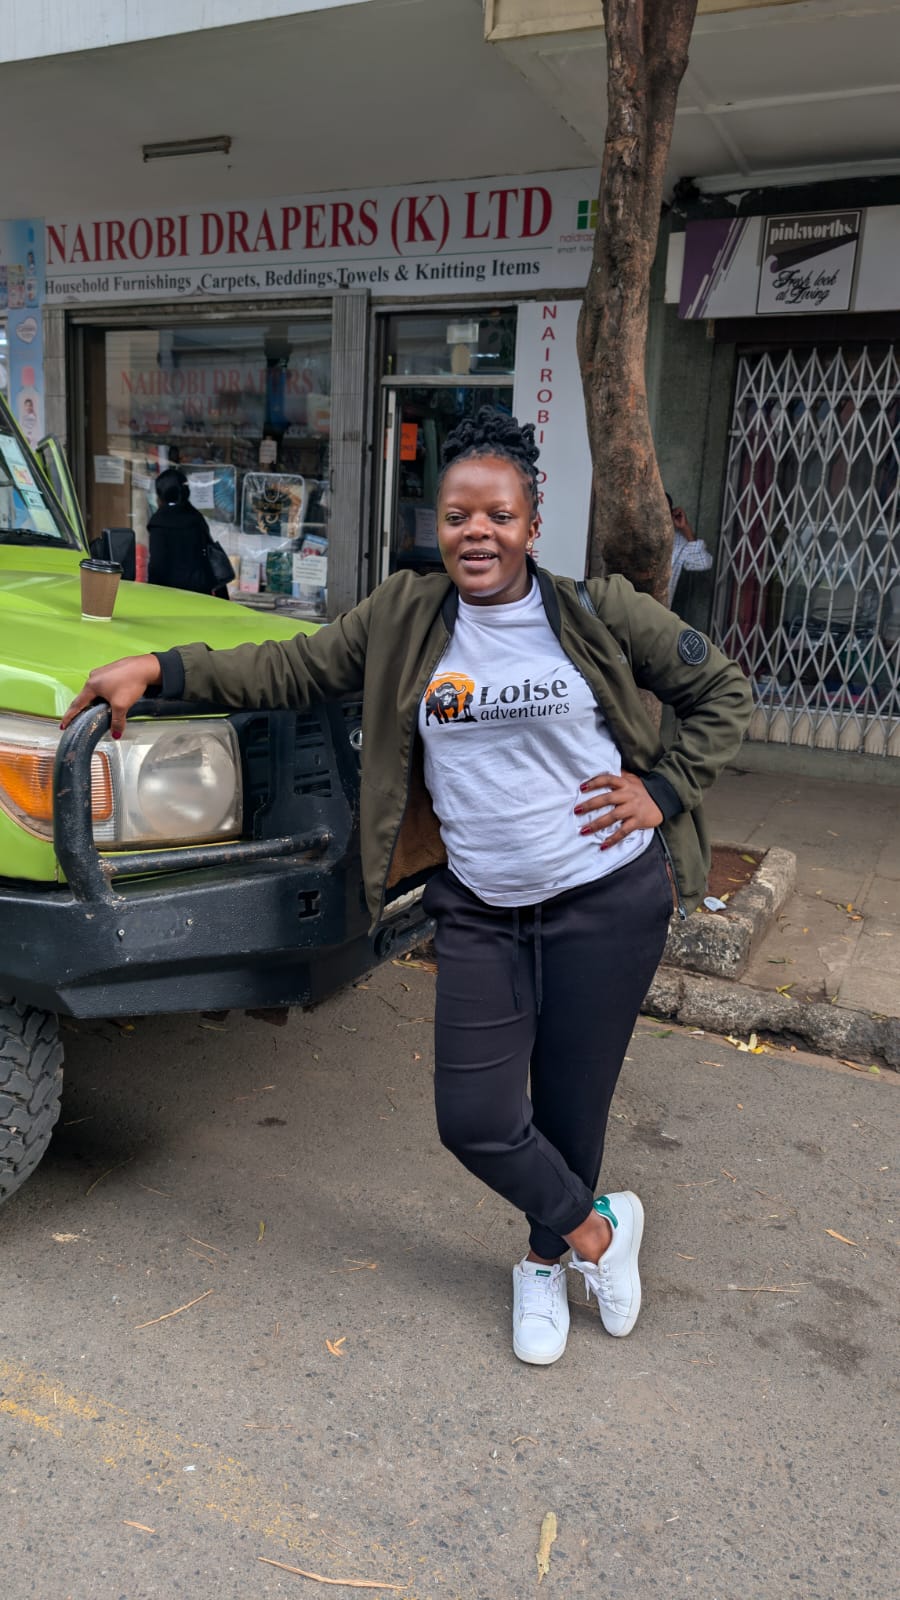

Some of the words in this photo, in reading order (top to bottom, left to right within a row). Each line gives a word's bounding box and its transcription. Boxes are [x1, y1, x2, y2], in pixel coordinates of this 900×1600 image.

[46, 214, 190, 265] NAIROBI
[200, 199, 378, 256] DRAPERS
[391, 194, 450, 255] (K)
[463, 186, 553, 240] LTD
[769, 219, 854, 245] pinkworths
[45, 277, 109, 294] Household
[397, 264, 409, 281] &
[415, 260, 486, 281] Knitting
[491, 258, 541, 276] Items
[537, 304, 557, 443] NAIROBI
[478, 679, 568, 706] Loise
[480, 701, 570, 721] adventures
